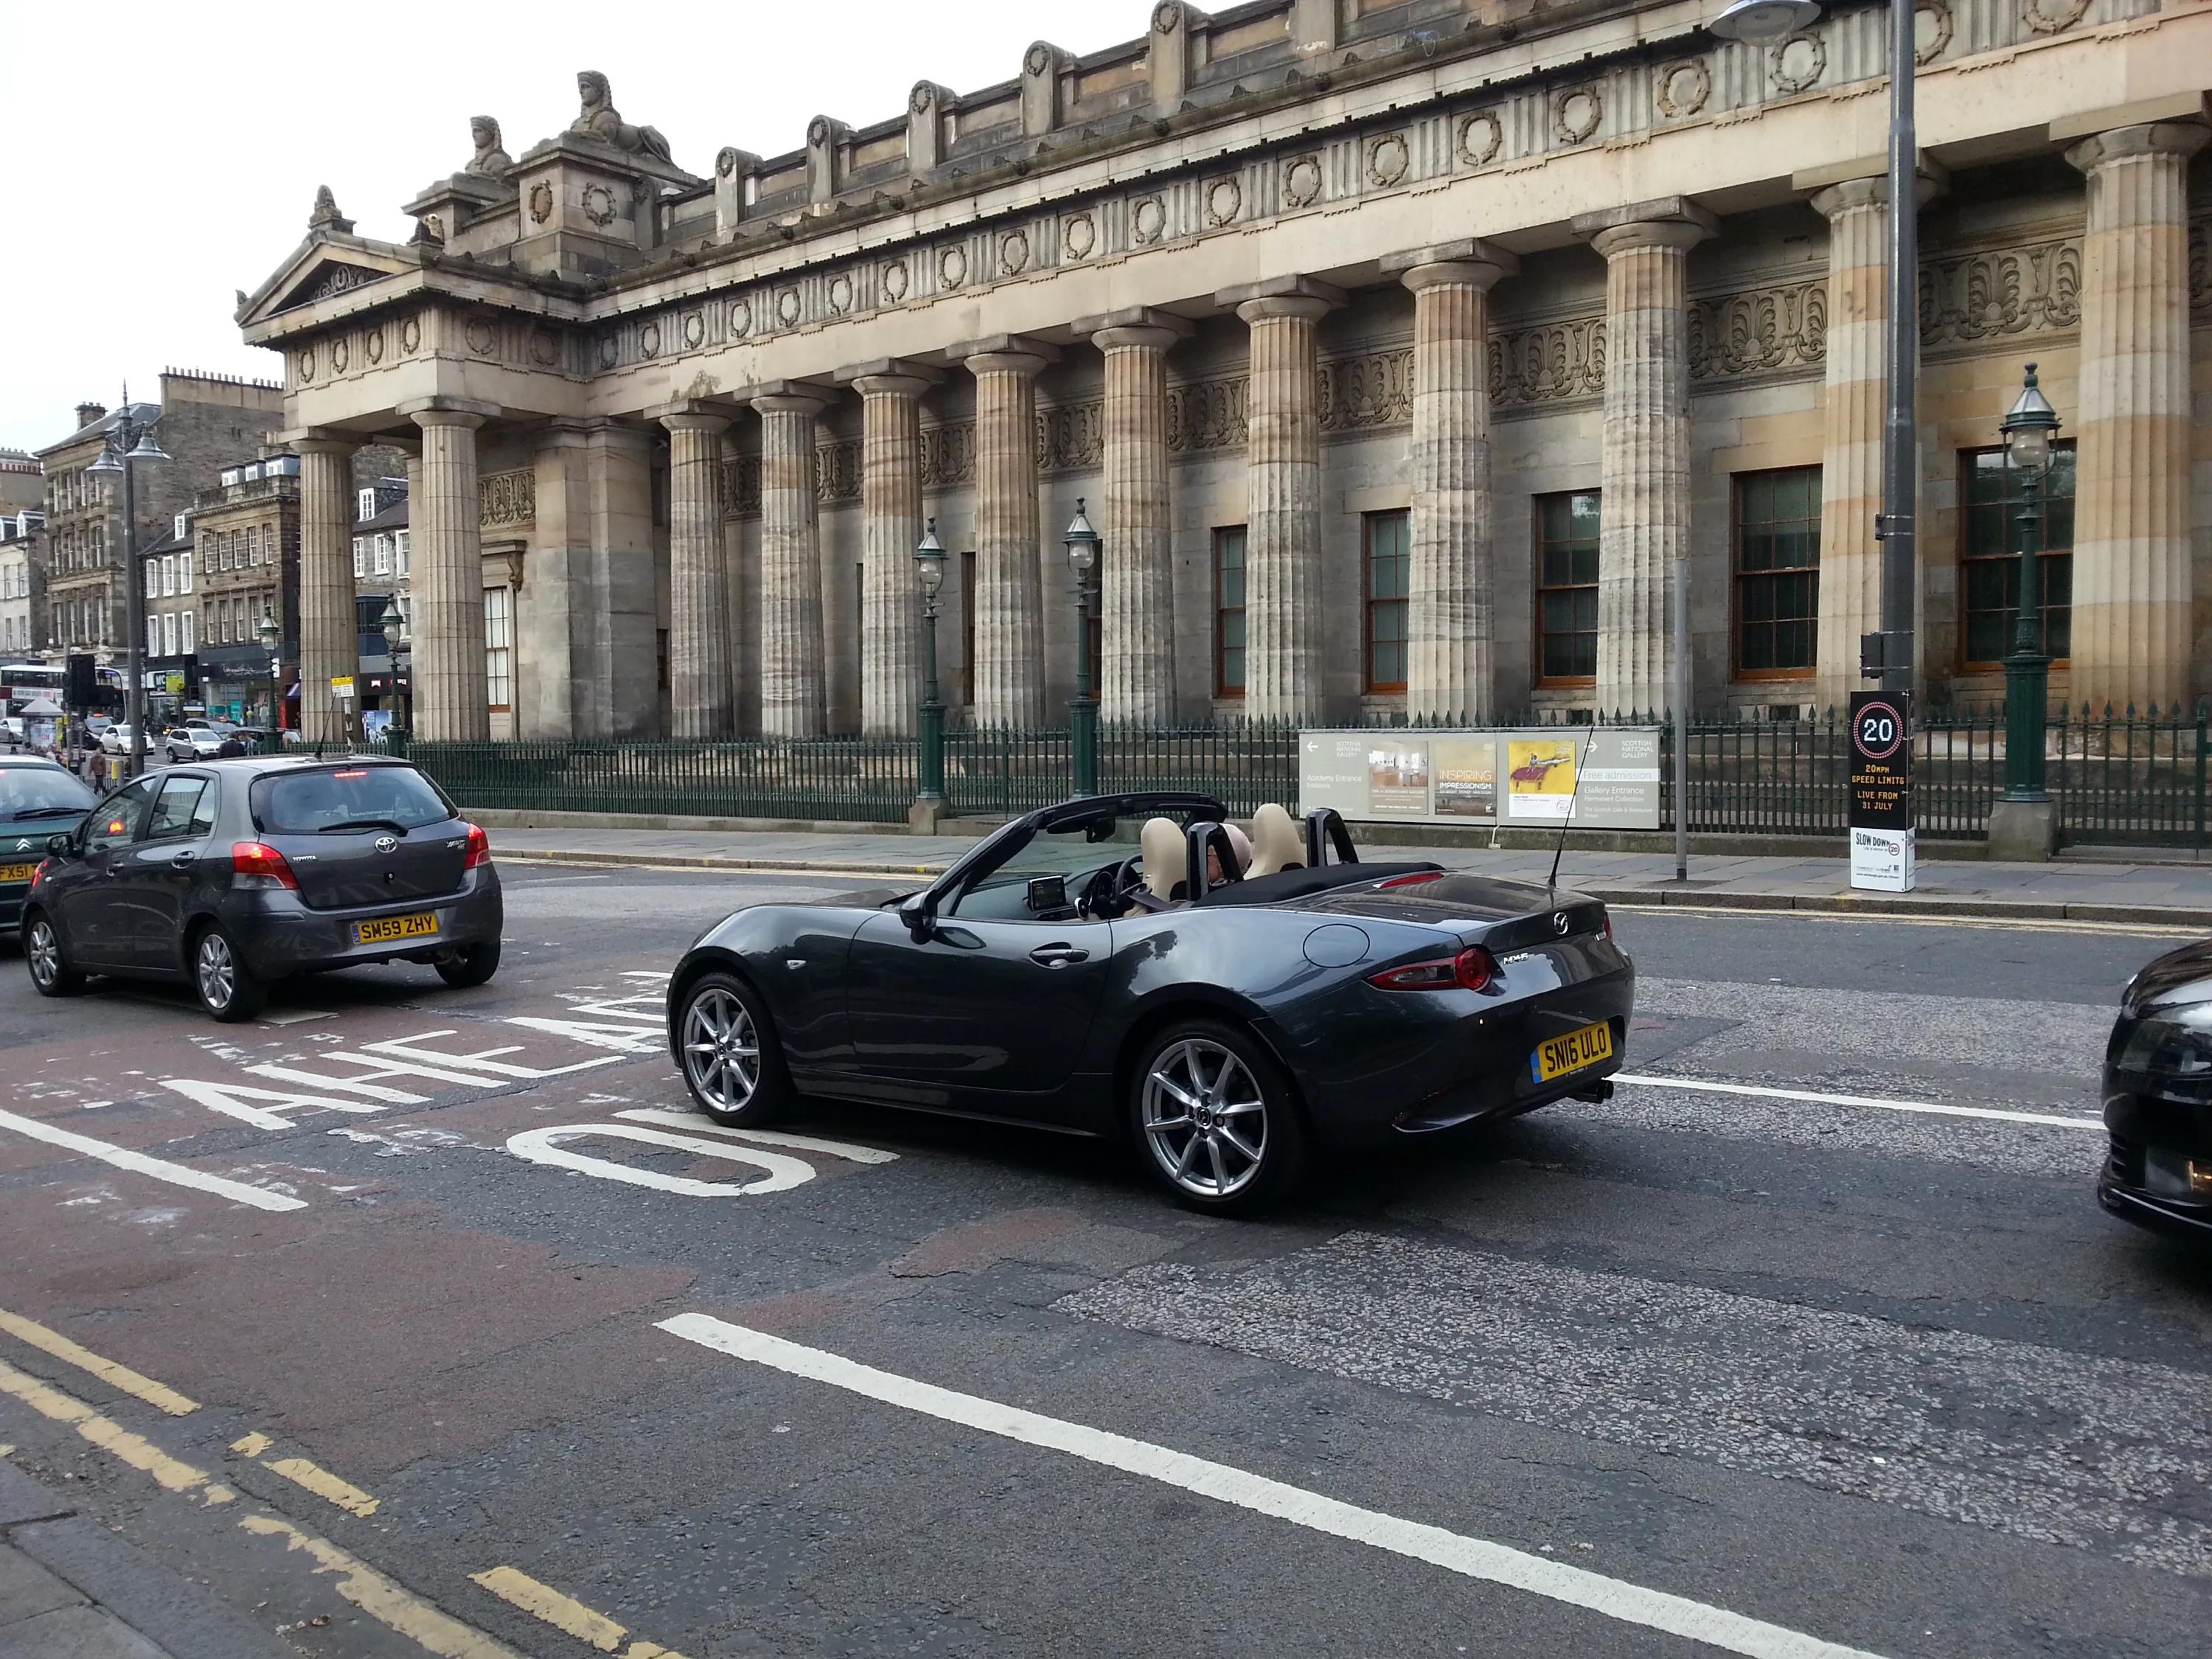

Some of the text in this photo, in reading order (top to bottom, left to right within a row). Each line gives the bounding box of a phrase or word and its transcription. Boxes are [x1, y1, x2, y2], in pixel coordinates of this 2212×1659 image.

[1864, 718, 1893, 742] 20
[1335, 774, 1363, 782] Entrance
[1439, 769, 1492, 781] INSPIRING
[1585, 771, 1652, 779] Free admission
[1851, 775, 1905, 785] SPEED LIMITS
[1439, 782, 1492, 790] IMPRESSIONISM
[1585, 786, 1645, 795] Gallery Entrance
[1857, 790, 1898, 800] LIVE FROM
[1863, 801, 1893, 810] 31 JULY
[1856, 832, 1891, 847] SLOW DOWN
[0, 866, 28, 878] FX51
[361, 916, 434, 939] SM59 ZHY
[1545, 1027, 1607, 1073] SN16 ULO
